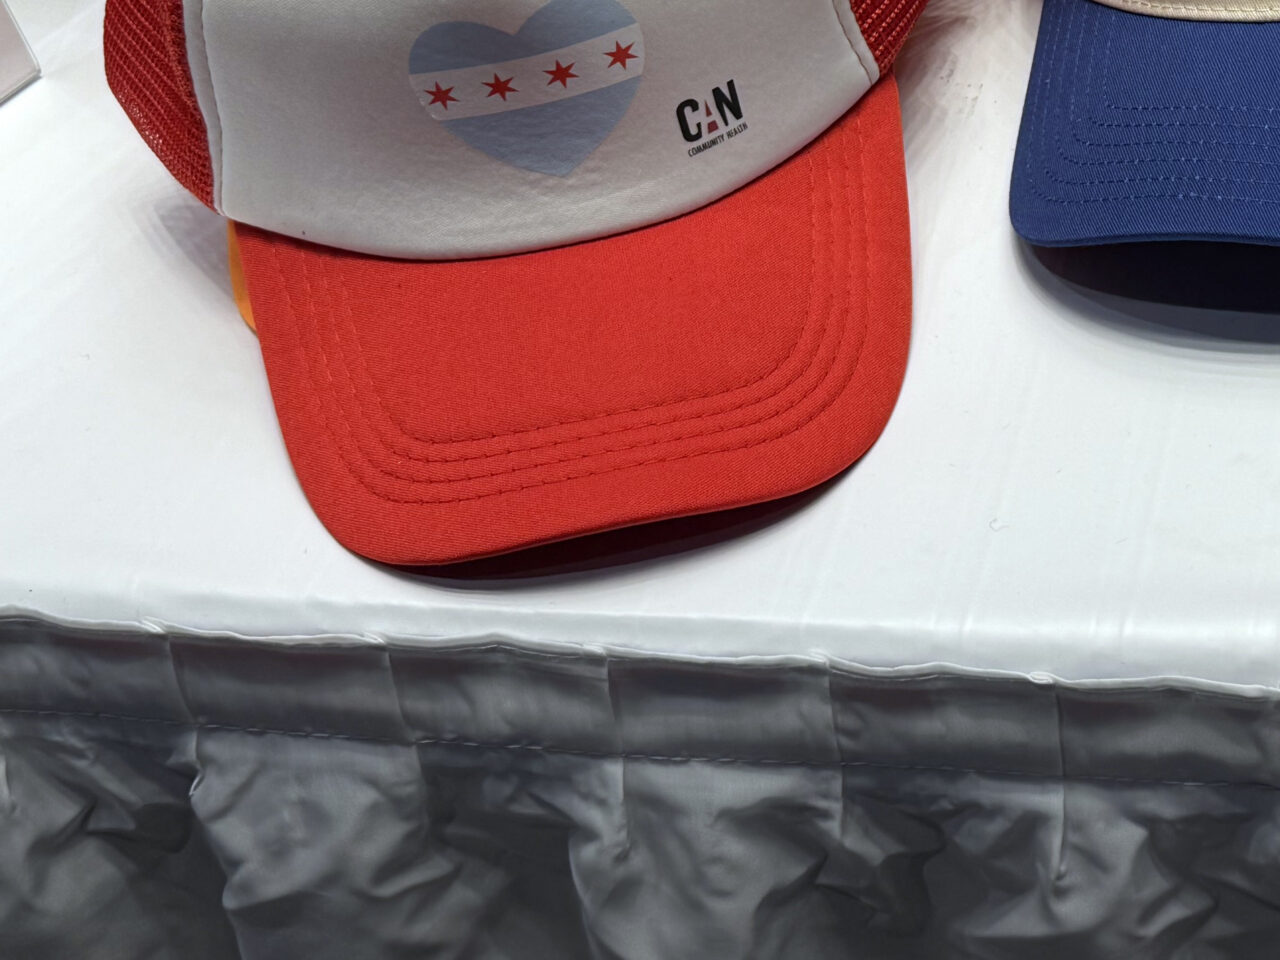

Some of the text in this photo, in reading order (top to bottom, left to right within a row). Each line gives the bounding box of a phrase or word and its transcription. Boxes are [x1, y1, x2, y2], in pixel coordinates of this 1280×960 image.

[676, 79, 743, 142] CAN
[688, 122, 748, 157] COMMUNITY HEALTH
